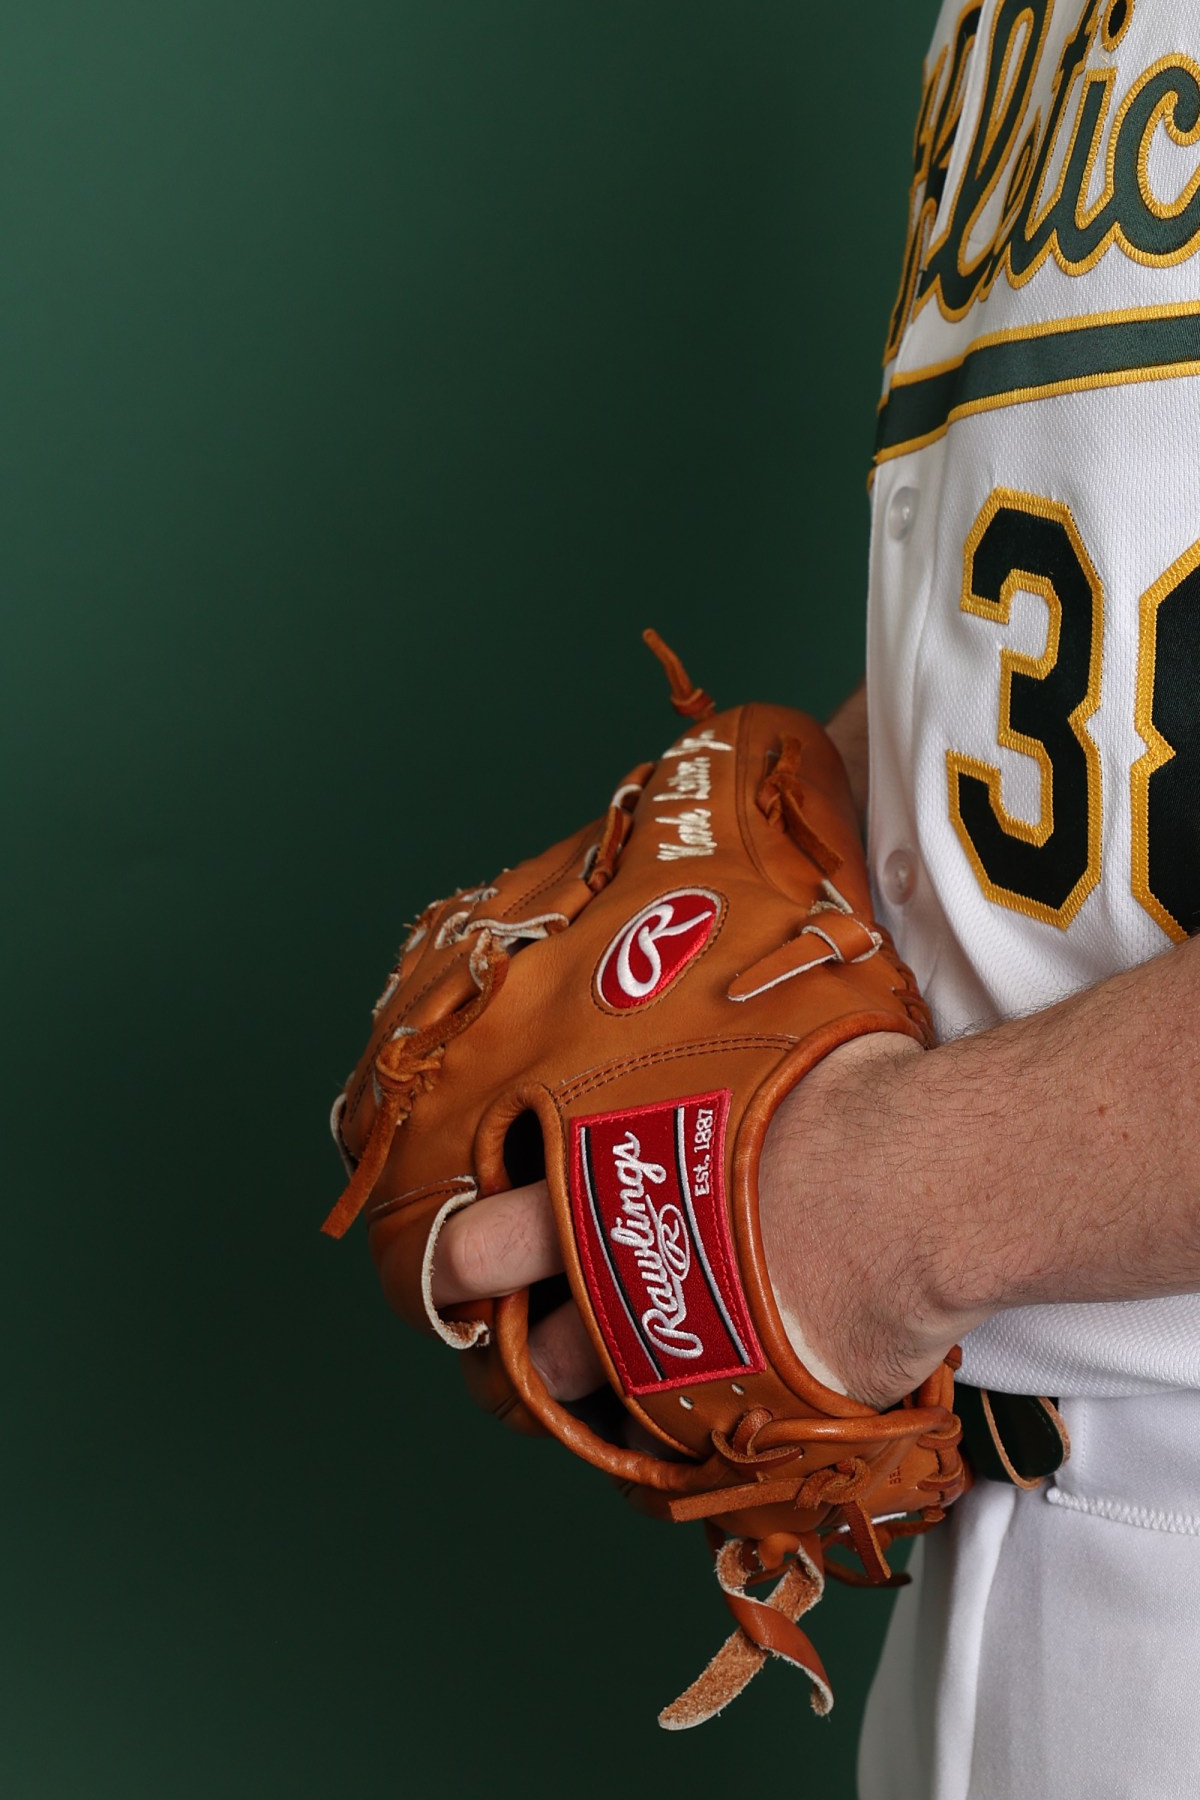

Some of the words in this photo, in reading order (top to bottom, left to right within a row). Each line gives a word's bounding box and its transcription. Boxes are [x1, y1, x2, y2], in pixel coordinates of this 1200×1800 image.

[693, 1108, 714, 1153] 1887
[694, 1154, 712, 1197] Est.
[610, 1131, 704, 1359] Rawlings
